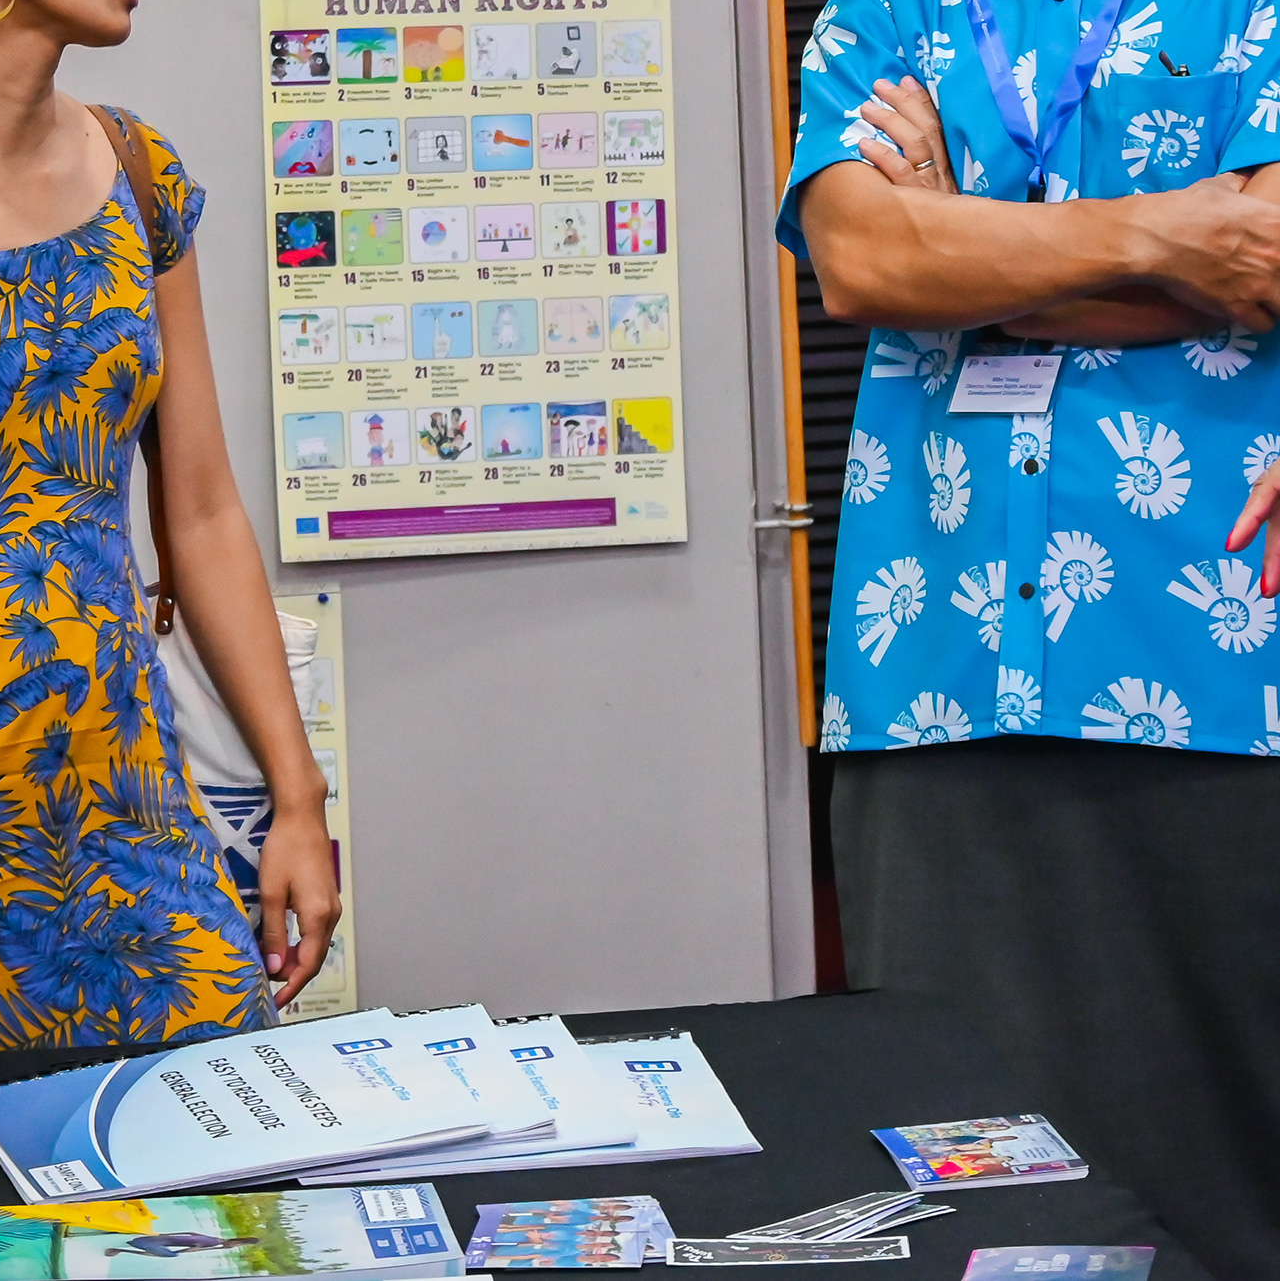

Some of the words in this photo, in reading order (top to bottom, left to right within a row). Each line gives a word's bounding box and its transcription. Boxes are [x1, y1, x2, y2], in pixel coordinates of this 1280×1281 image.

[405, 87, 411, 99] 3
[471, 85, 478, 97] 4
[538, 83, 544, 95] 5
[604, 81, 611, 93] 6
[272, 91, 276, 103] 1
[338, 89, 344, 101] 2
[474, 176, 486, 188] 10
[540, 174, 549, 186] 11
[606, 172, 617, 184] 12
[274, 183, 279, 195] 7
[341, 181, 348, 193] 8
[407, 179, 414, 191] 9
[477, 267, 489, 279] 16
[543, 265, 553, 277] 17
[608, 263, 620, 274] 18
[278, 275, 290, 287] 13
[344, 273, 356, 284] 14
[412, 270, 424, 282] 15
[480, 363, 494, 375] 22
[546, 361, 560, 373] 23
[612, 358, 625, 370] 24
[282, 372, 294, 384] 19
[348, 369, 362, 381] 20
[415, 366, 427, 378] 21
[484, 467, 498, 480] 28
[550, 464, 564, 477] 29
[615, 461, 629, 474] 30
[286, 477, 300, 489] 25
[352, 474, 366, 486] 26
[420, 471, 431, 483] 27
[206, 1058, 240, 1077] EASY
[223, 1077, 247, 1087] TO
[250, 1044, 295, 1078] ASSISTED
[281, 1076, 321, 1103] VOTING
[304, 1102, 342, 1128] STEPS
[231, 1086, 264, 1106] READ
[159, 1070, 201, 1104] GENERAL
[185, 1100, 233, 1139] ELECTION
[249, 1105, 285, 1131] GUIDE
[54, 1163, 80, 1182] SAMPLE
